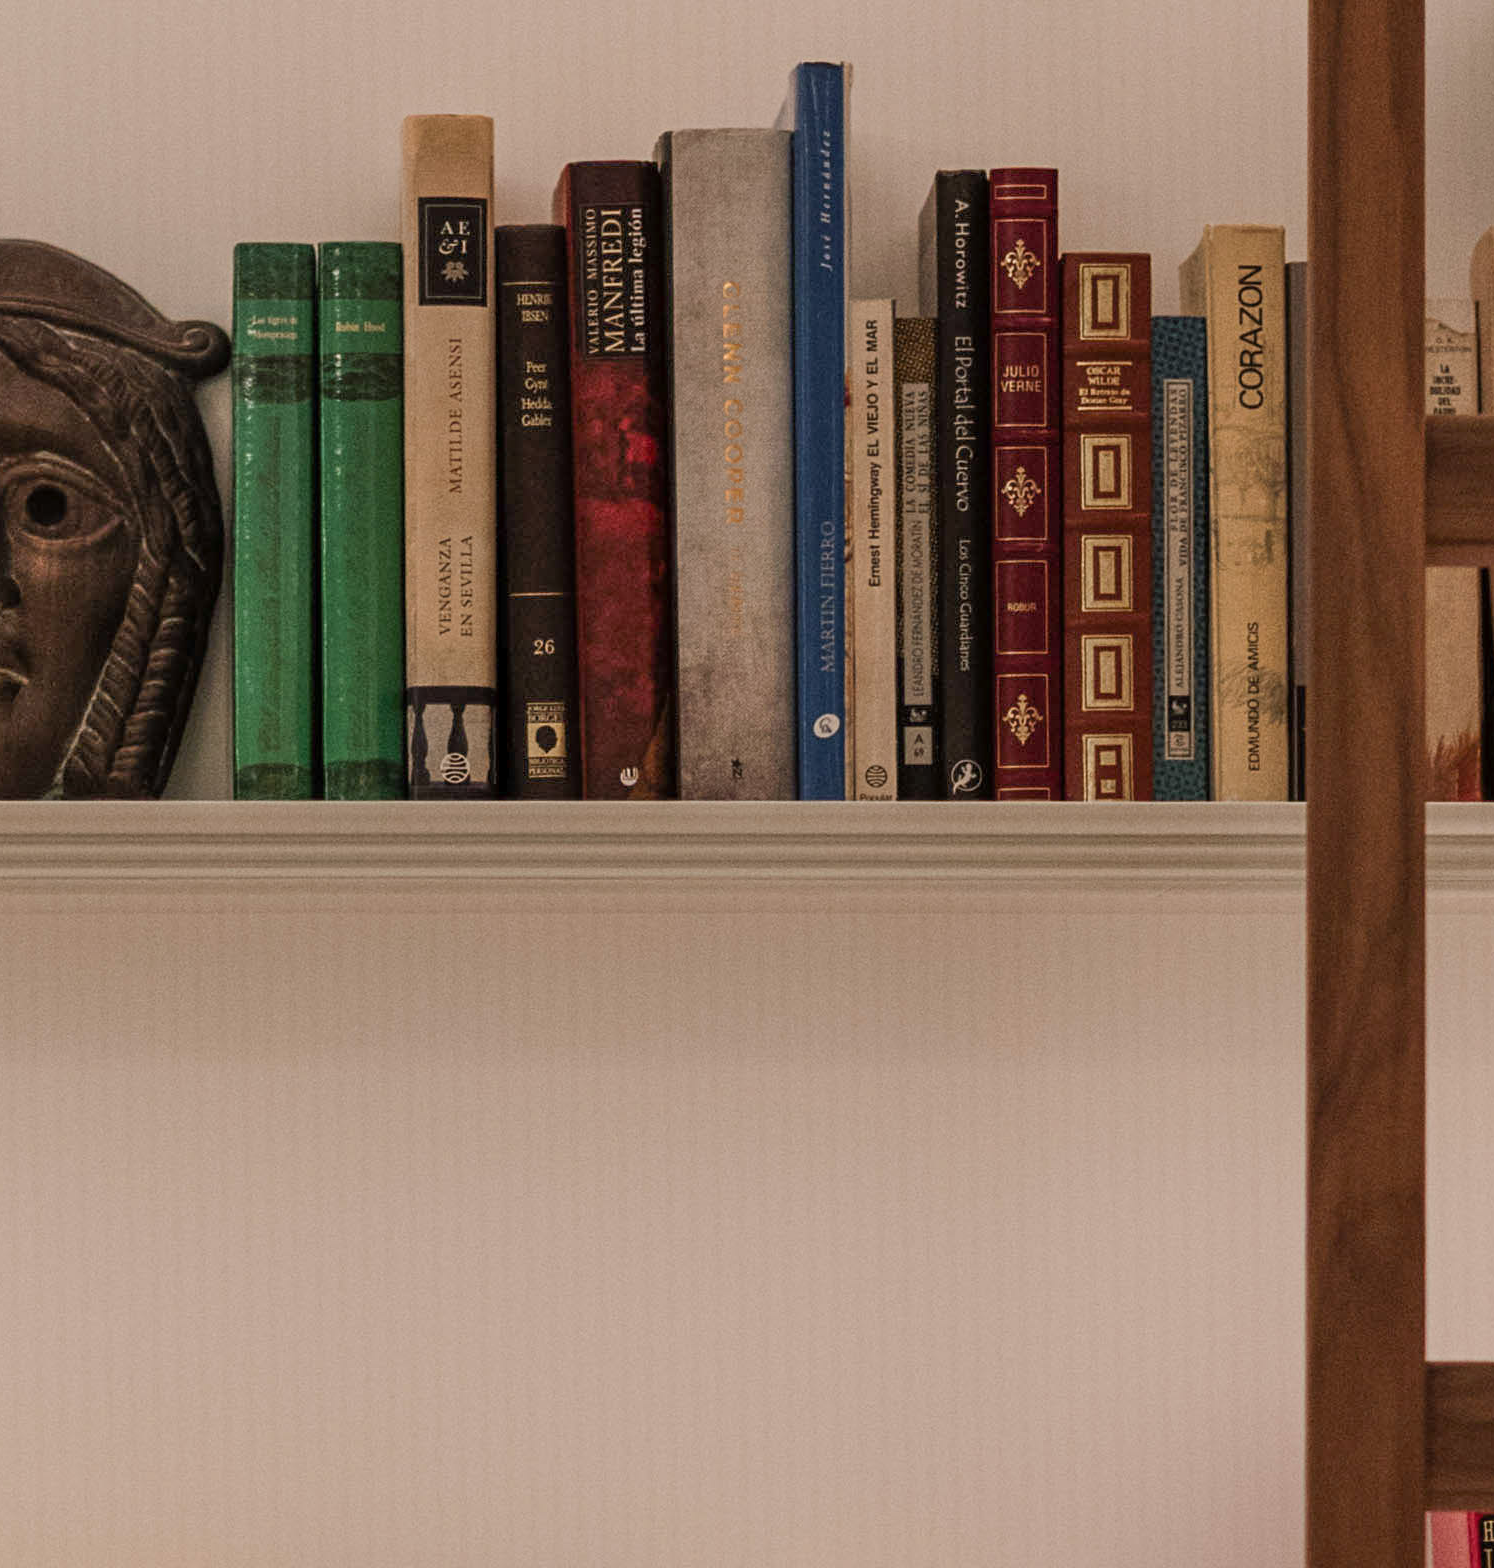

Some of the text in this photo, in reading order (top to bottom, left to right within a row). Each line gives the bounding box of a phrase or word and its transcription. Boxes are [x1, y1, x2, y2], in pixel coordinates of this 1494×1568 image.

[602, 208, 623, 354] MANFREDI
[629, 208, 646, 352] La última legión
[954, 222, 968, 309] Horowitz
[1238, 265, 1264, 409] CORAZON
[450, 338, 463, 493] MATILDE ASENSI
[866, 319, 880, 457] EL VIEJO Y EL MAR
[954, 336, 976, 512] El Portal del Cuervo
[439, 536, 453, 636] VENGANZA
[460, 535, 474, 637] EN SEVILLA
[868, 462, 882, 588] Ernest Hemingway
[1247, 621, 1260, 772] EDMUNDO DE AMICIS
